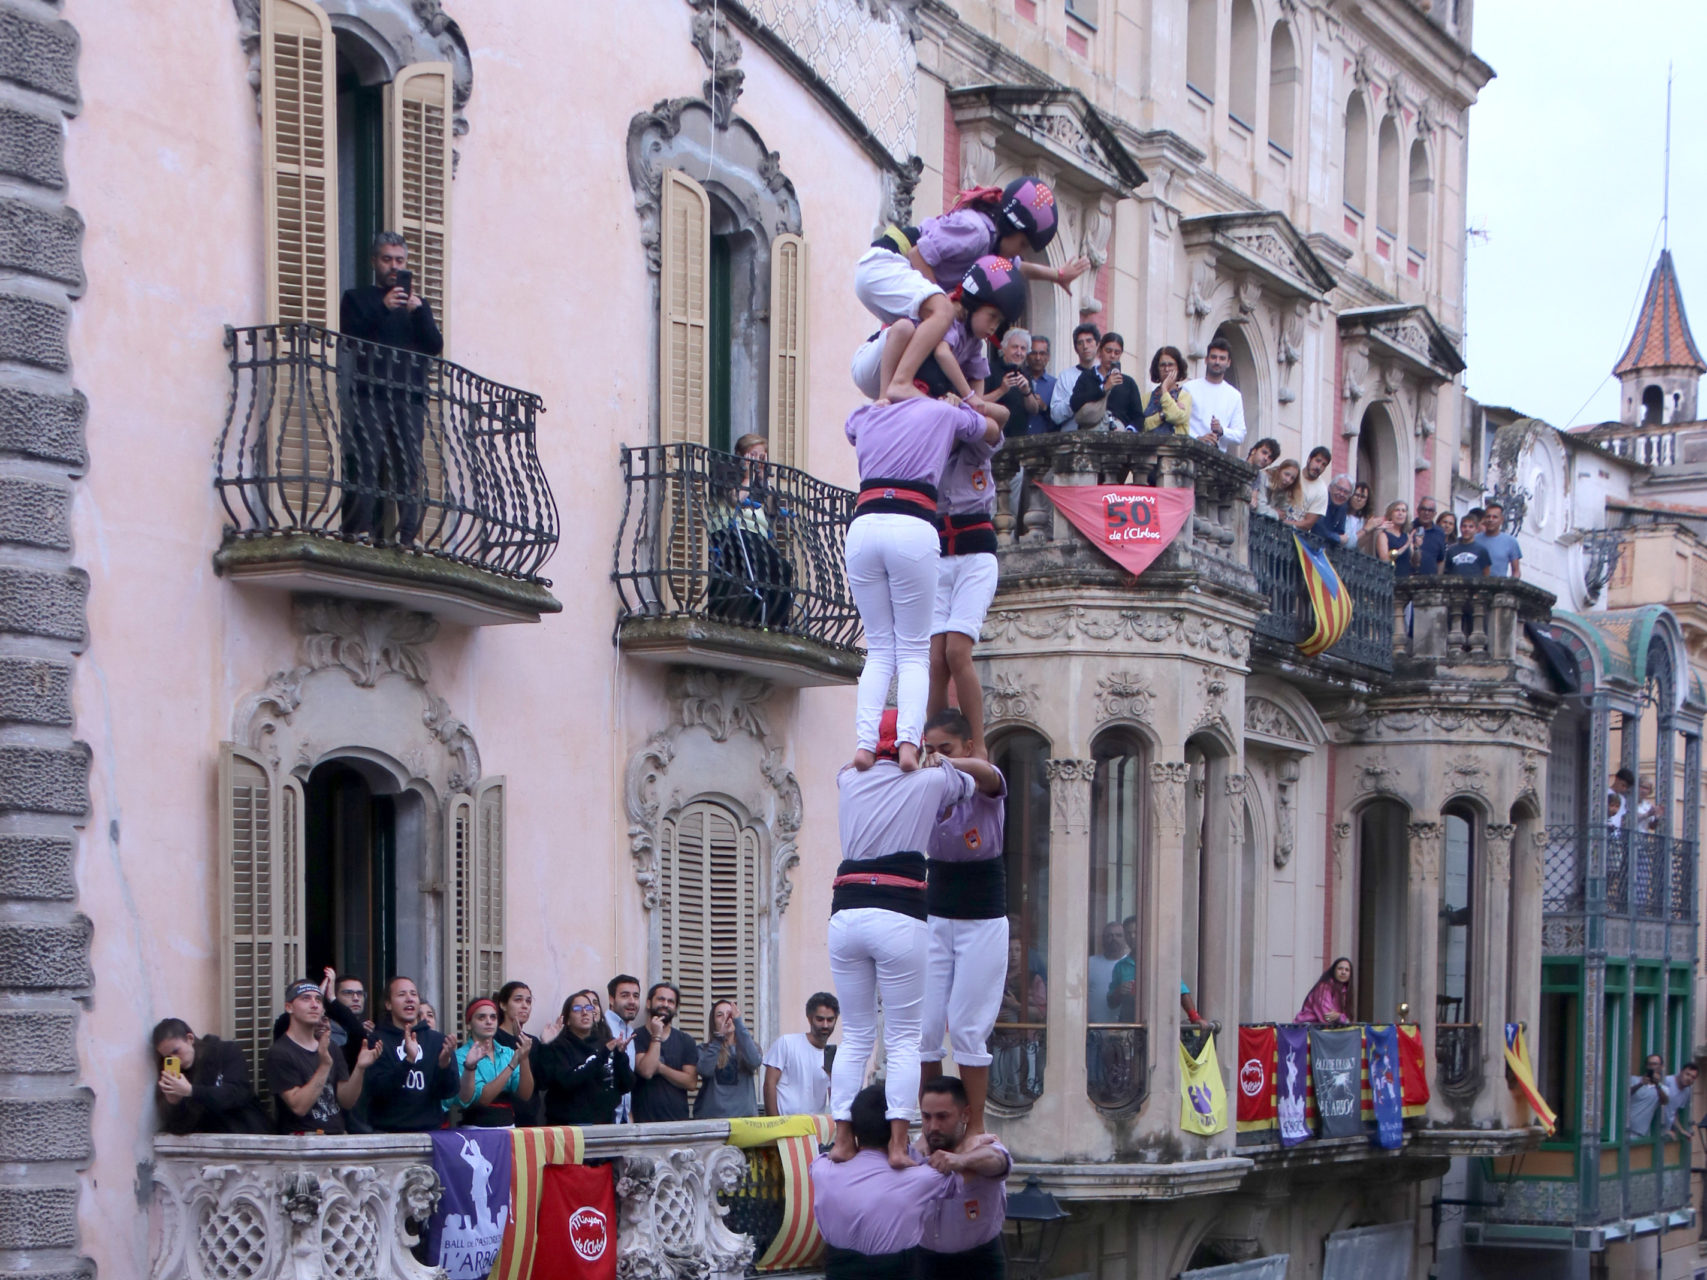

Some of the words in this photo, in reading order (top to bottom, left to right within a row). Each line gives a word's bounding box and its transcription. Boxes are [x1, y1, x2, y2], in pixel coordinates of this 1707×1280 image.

[1102, 493, 1155, 504] Minyons
[1107, 501, 1151, 528] 50
[1109, 531, 1122, 540] de
[444, 1239, 465, 1249] BALL
[442, 1248, 500, 1273] L'ARBO
